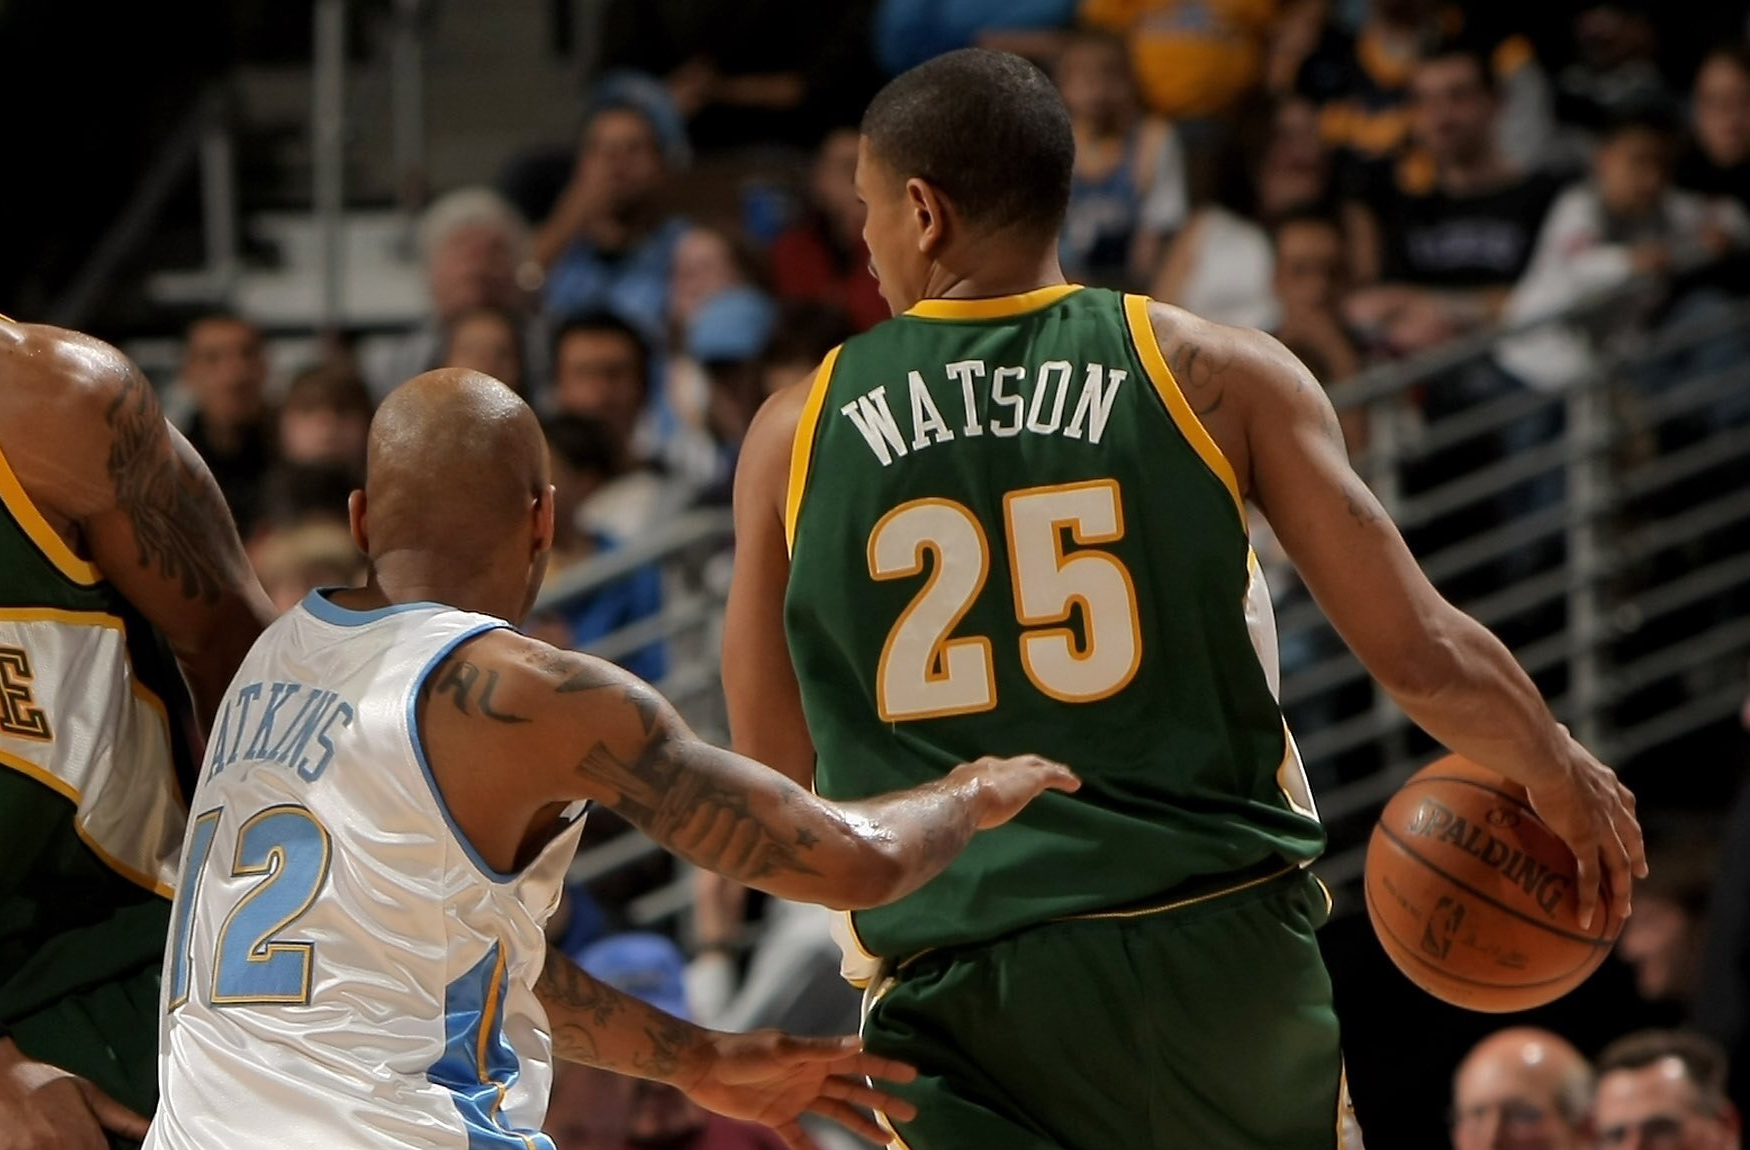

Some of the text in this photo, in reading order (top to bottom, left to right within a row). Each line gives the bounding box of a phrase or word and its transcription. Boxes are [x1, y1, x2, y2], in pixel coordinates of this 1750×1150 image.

[841, 360, 1127, 466] WATSON
[866, 478, 1142, 721] 25
[205, 682, 354, 784] ATKINS
[168, 803, 333, 1015] 12
[1407, 799, 1571, 919] SPALDING
